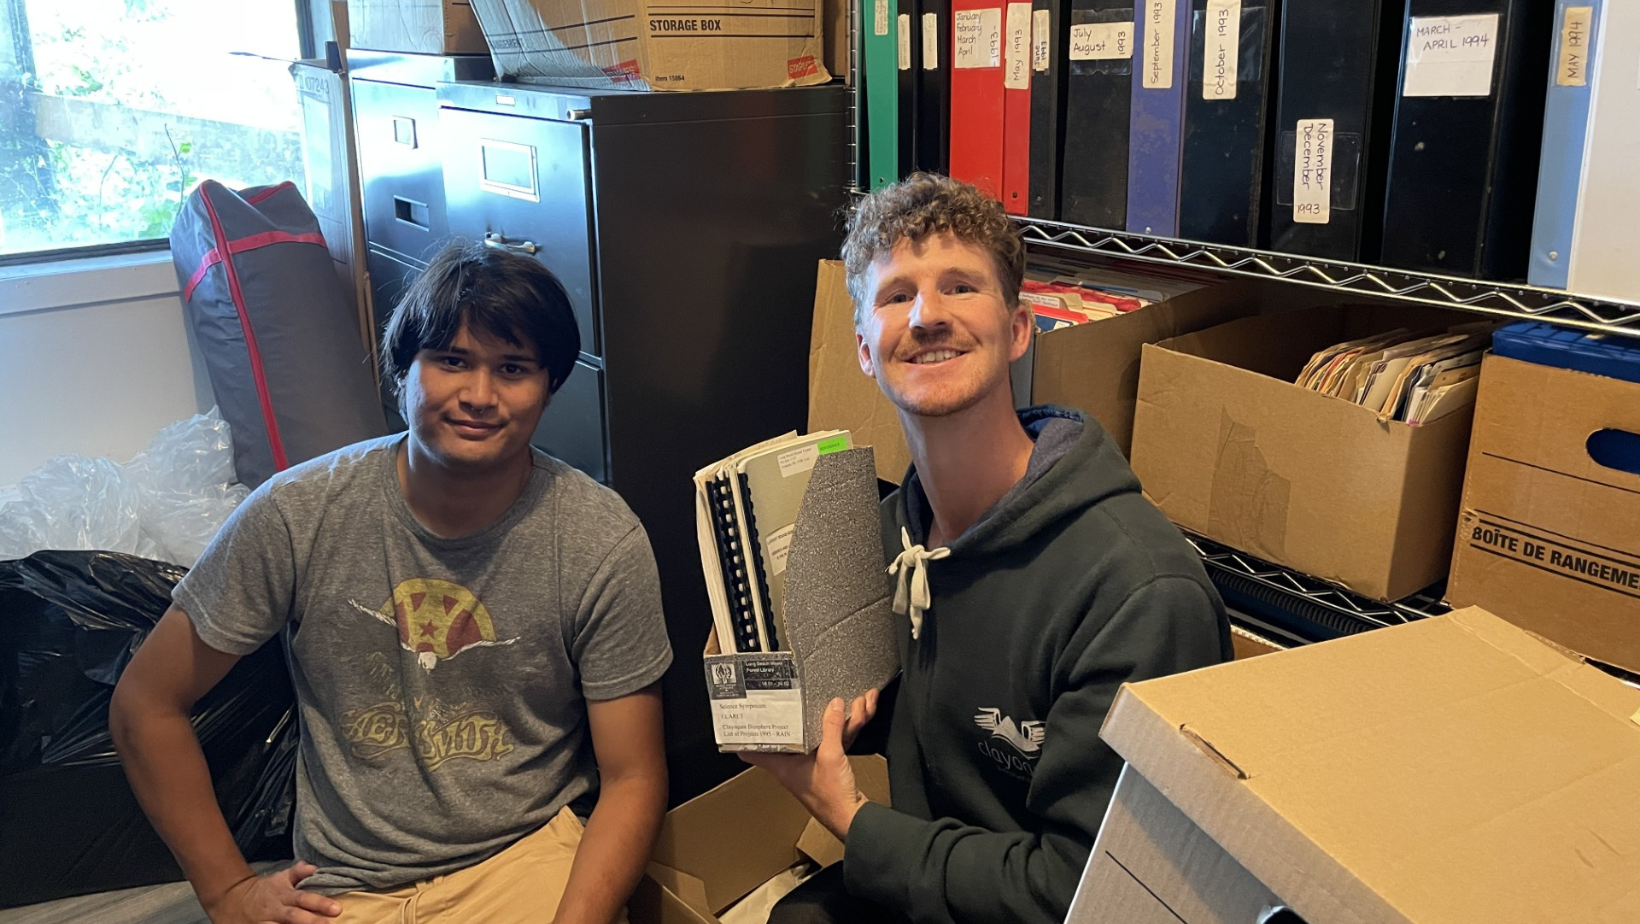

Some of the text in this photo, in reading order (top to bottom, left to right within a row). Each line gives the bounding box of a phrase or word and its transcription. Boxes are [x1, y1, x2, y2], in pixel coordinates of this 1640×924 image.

[649, 19, 721, 32] STORAGE BOX
[955, 12, 982, 24] January
[956, 24, 983, 37] February
[1073, 28, 1092, 41] July
[1416, 26, 1450, 37] MARCH
[957, 36, 977, 44] March
[990, 32, 999, 58] 1993
[1073, 41, 1106, 55] August
[1117, 31, 1126, 55] 1993
[1151, 2, 1163, 84] September 1993
[1423, 33, 1490, 51] APRIL 1994
[957, 47, 973, 59] April
[1013, 29, 1023, 81] May 1993
[1215, 9, 1229, 95] October 1993
[1567, 20, 1583, 79] MAY 1994
[1302, 123, 1314, 190] December
[1315, 122, 1329, 191] November
[1297, 203, 1321, 215] 1993
[1472, 526, 1640, 590] BOÎTE DE RANGEME
[739, 703, 767, 711] Symposium
[341, 702, 515, 771] AERSMITH
